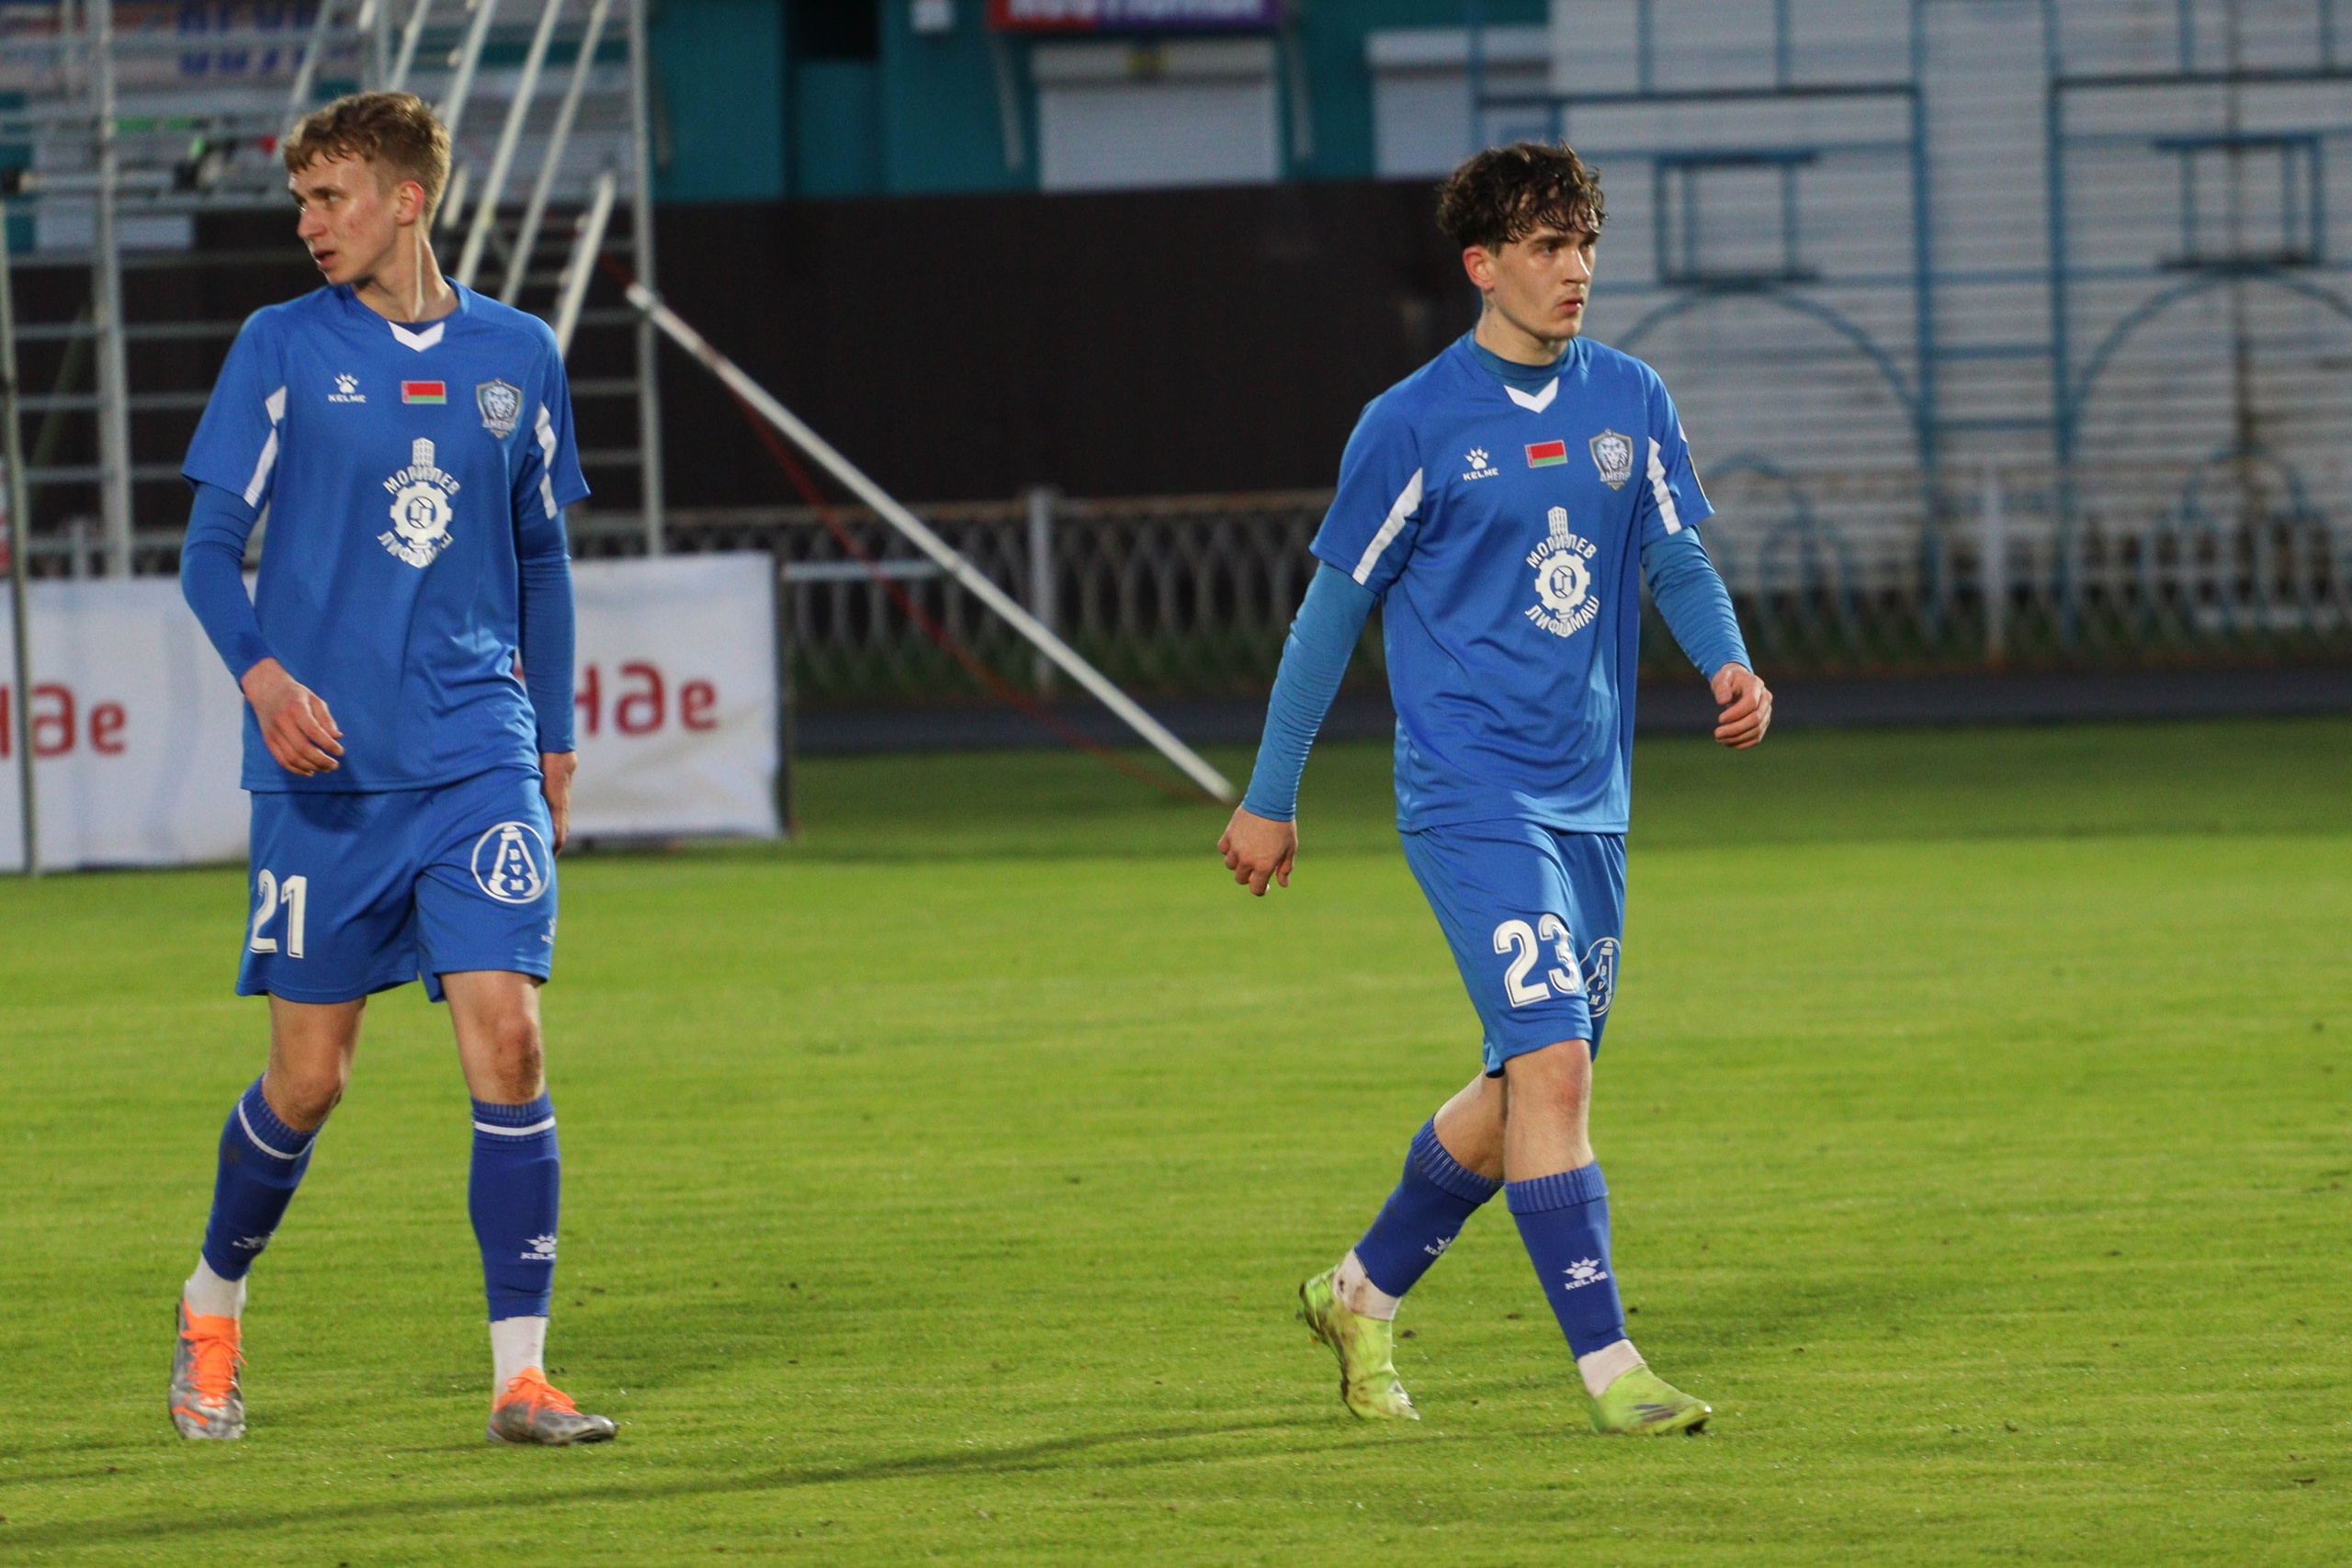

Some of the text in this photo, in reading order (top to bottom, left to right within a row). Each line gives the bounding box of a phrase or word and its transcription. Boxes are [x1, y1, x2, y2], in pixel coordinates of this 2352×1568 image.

[328, 393, 368, 403] KELME
[1463, 467, 1499, 481] KELME
[249, 869, 308, 959] 21
[1492, 912, 1582, 1009] 23
[1565, 1271, 1609, 1291] KELME
